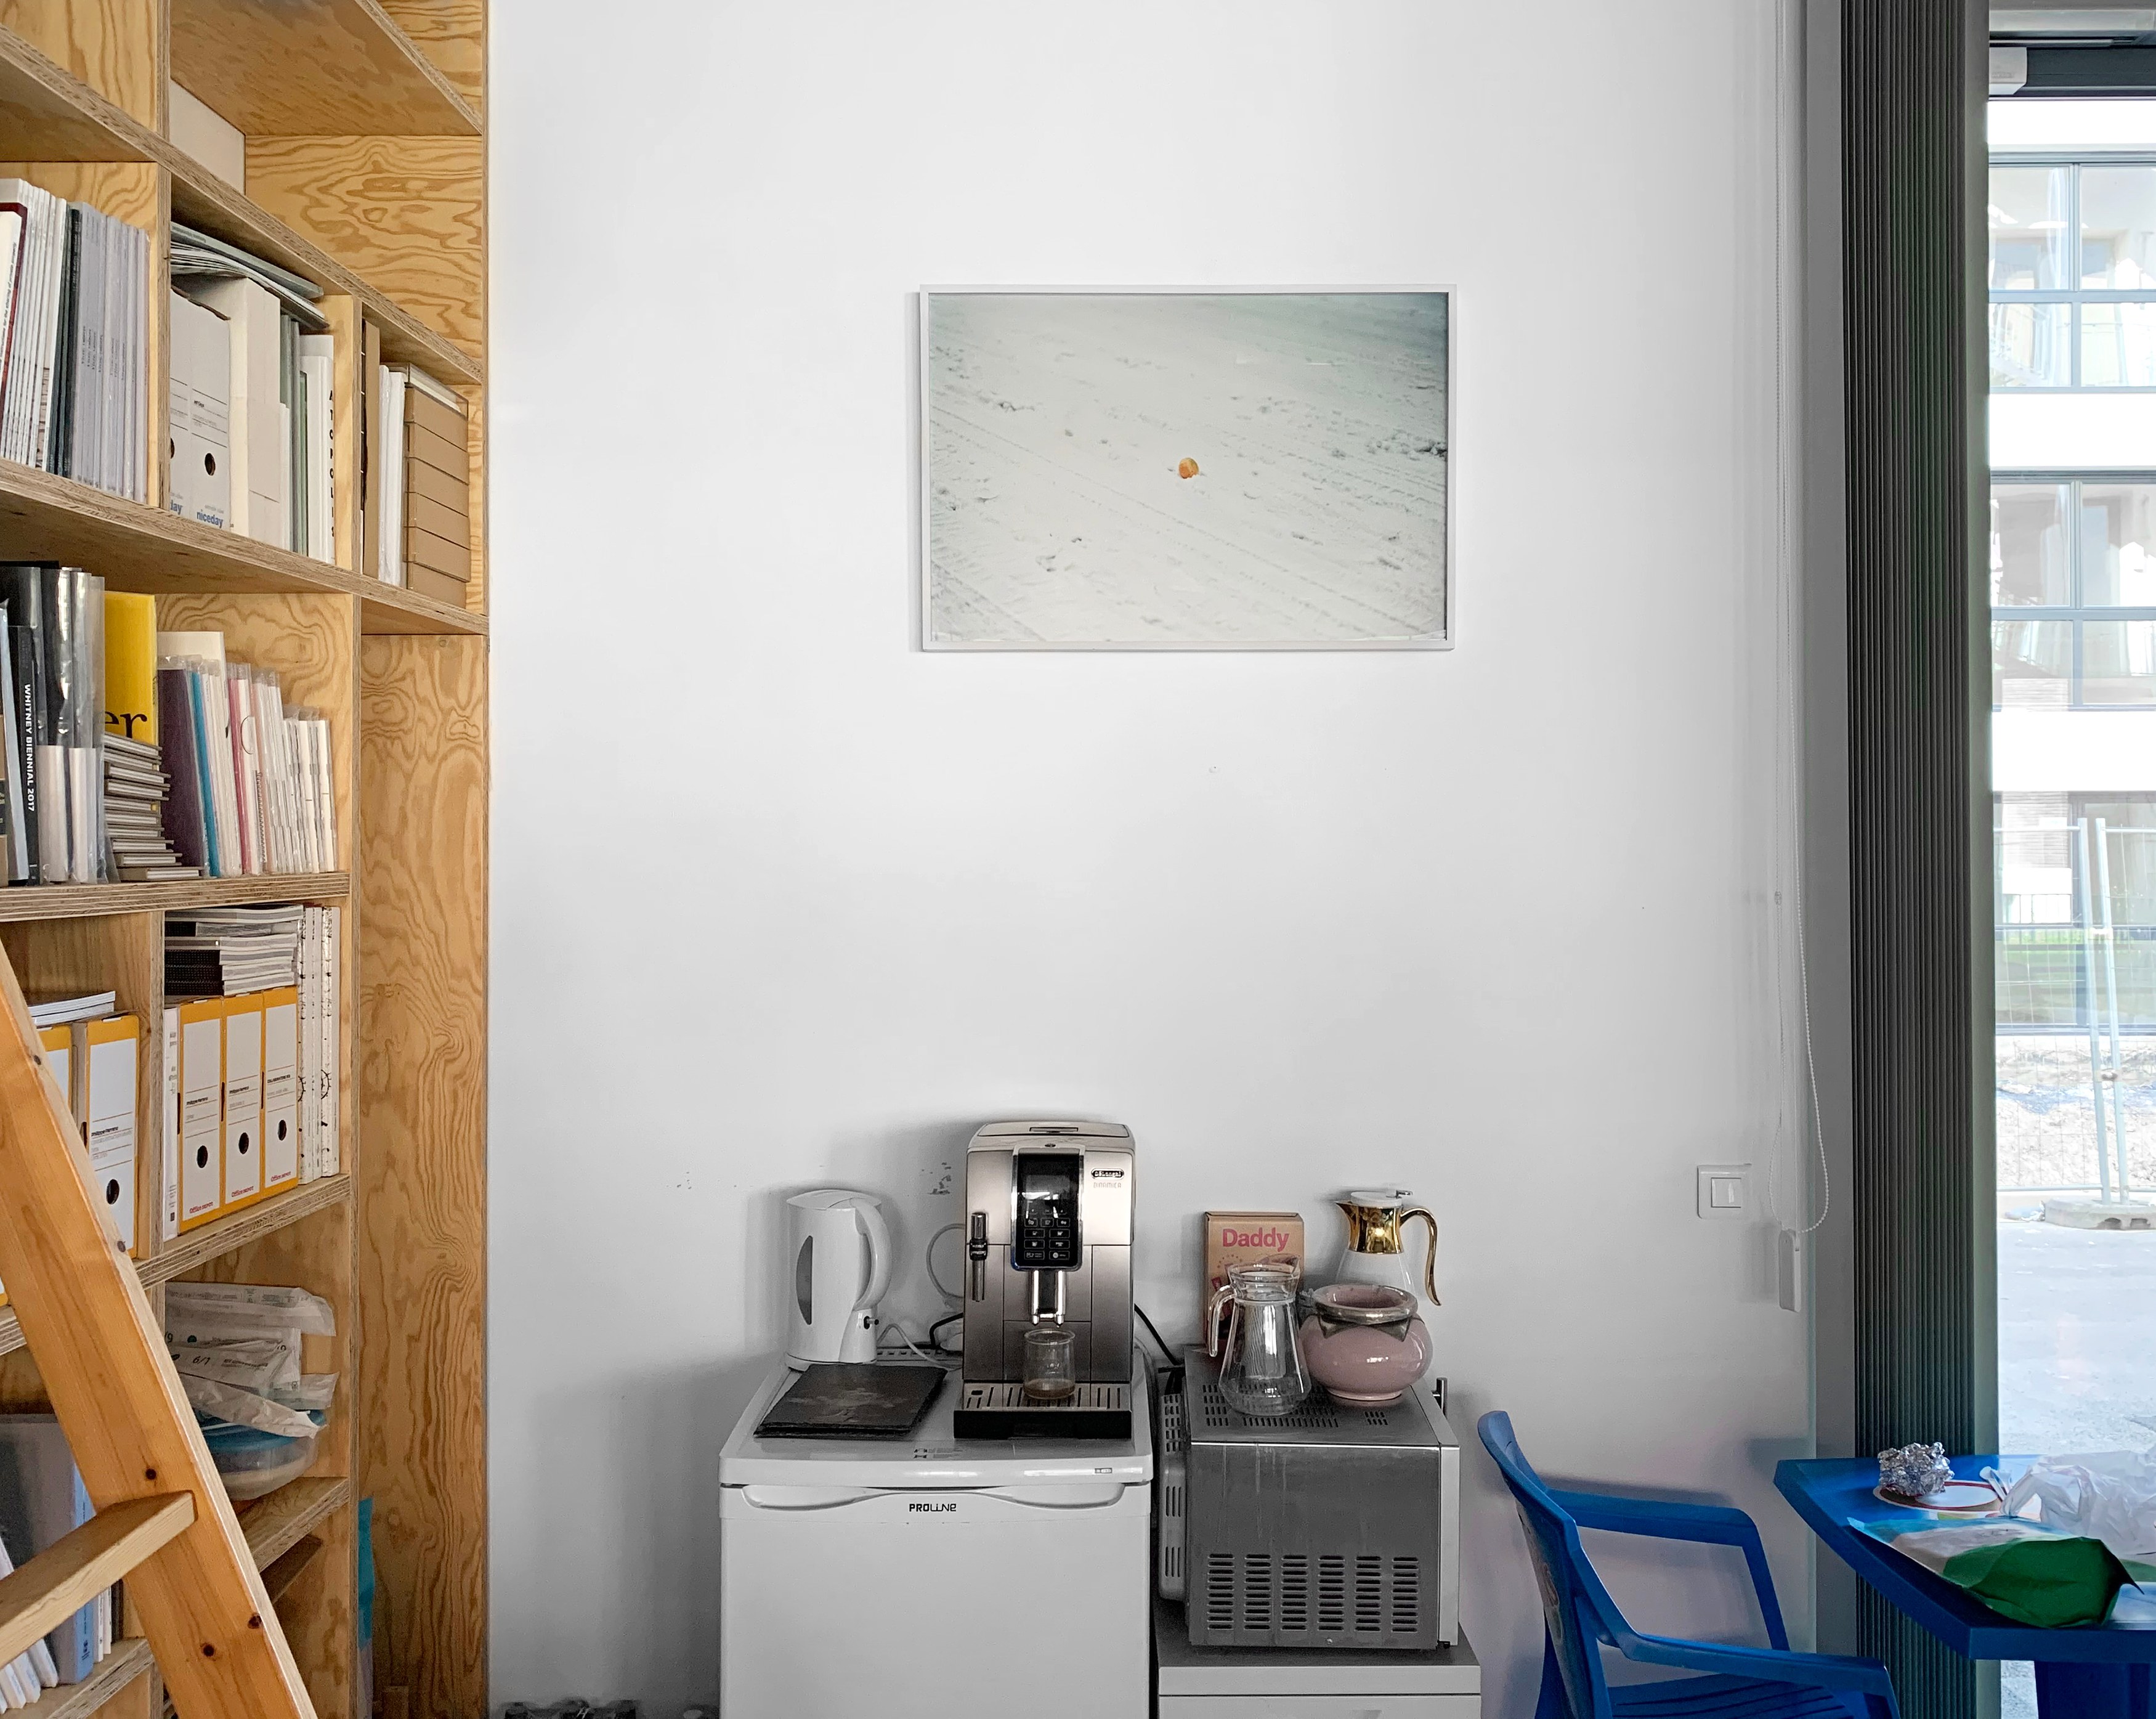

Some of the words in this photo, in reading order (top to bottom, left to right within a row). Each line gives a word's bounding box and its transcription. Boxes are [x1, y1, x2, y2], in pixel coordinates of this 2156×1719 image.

[197, 509, 223, 529] niceday
[24, 684, 32, 734] WHITNEY
[1222, 1227, 1290, 1253] Daddy
